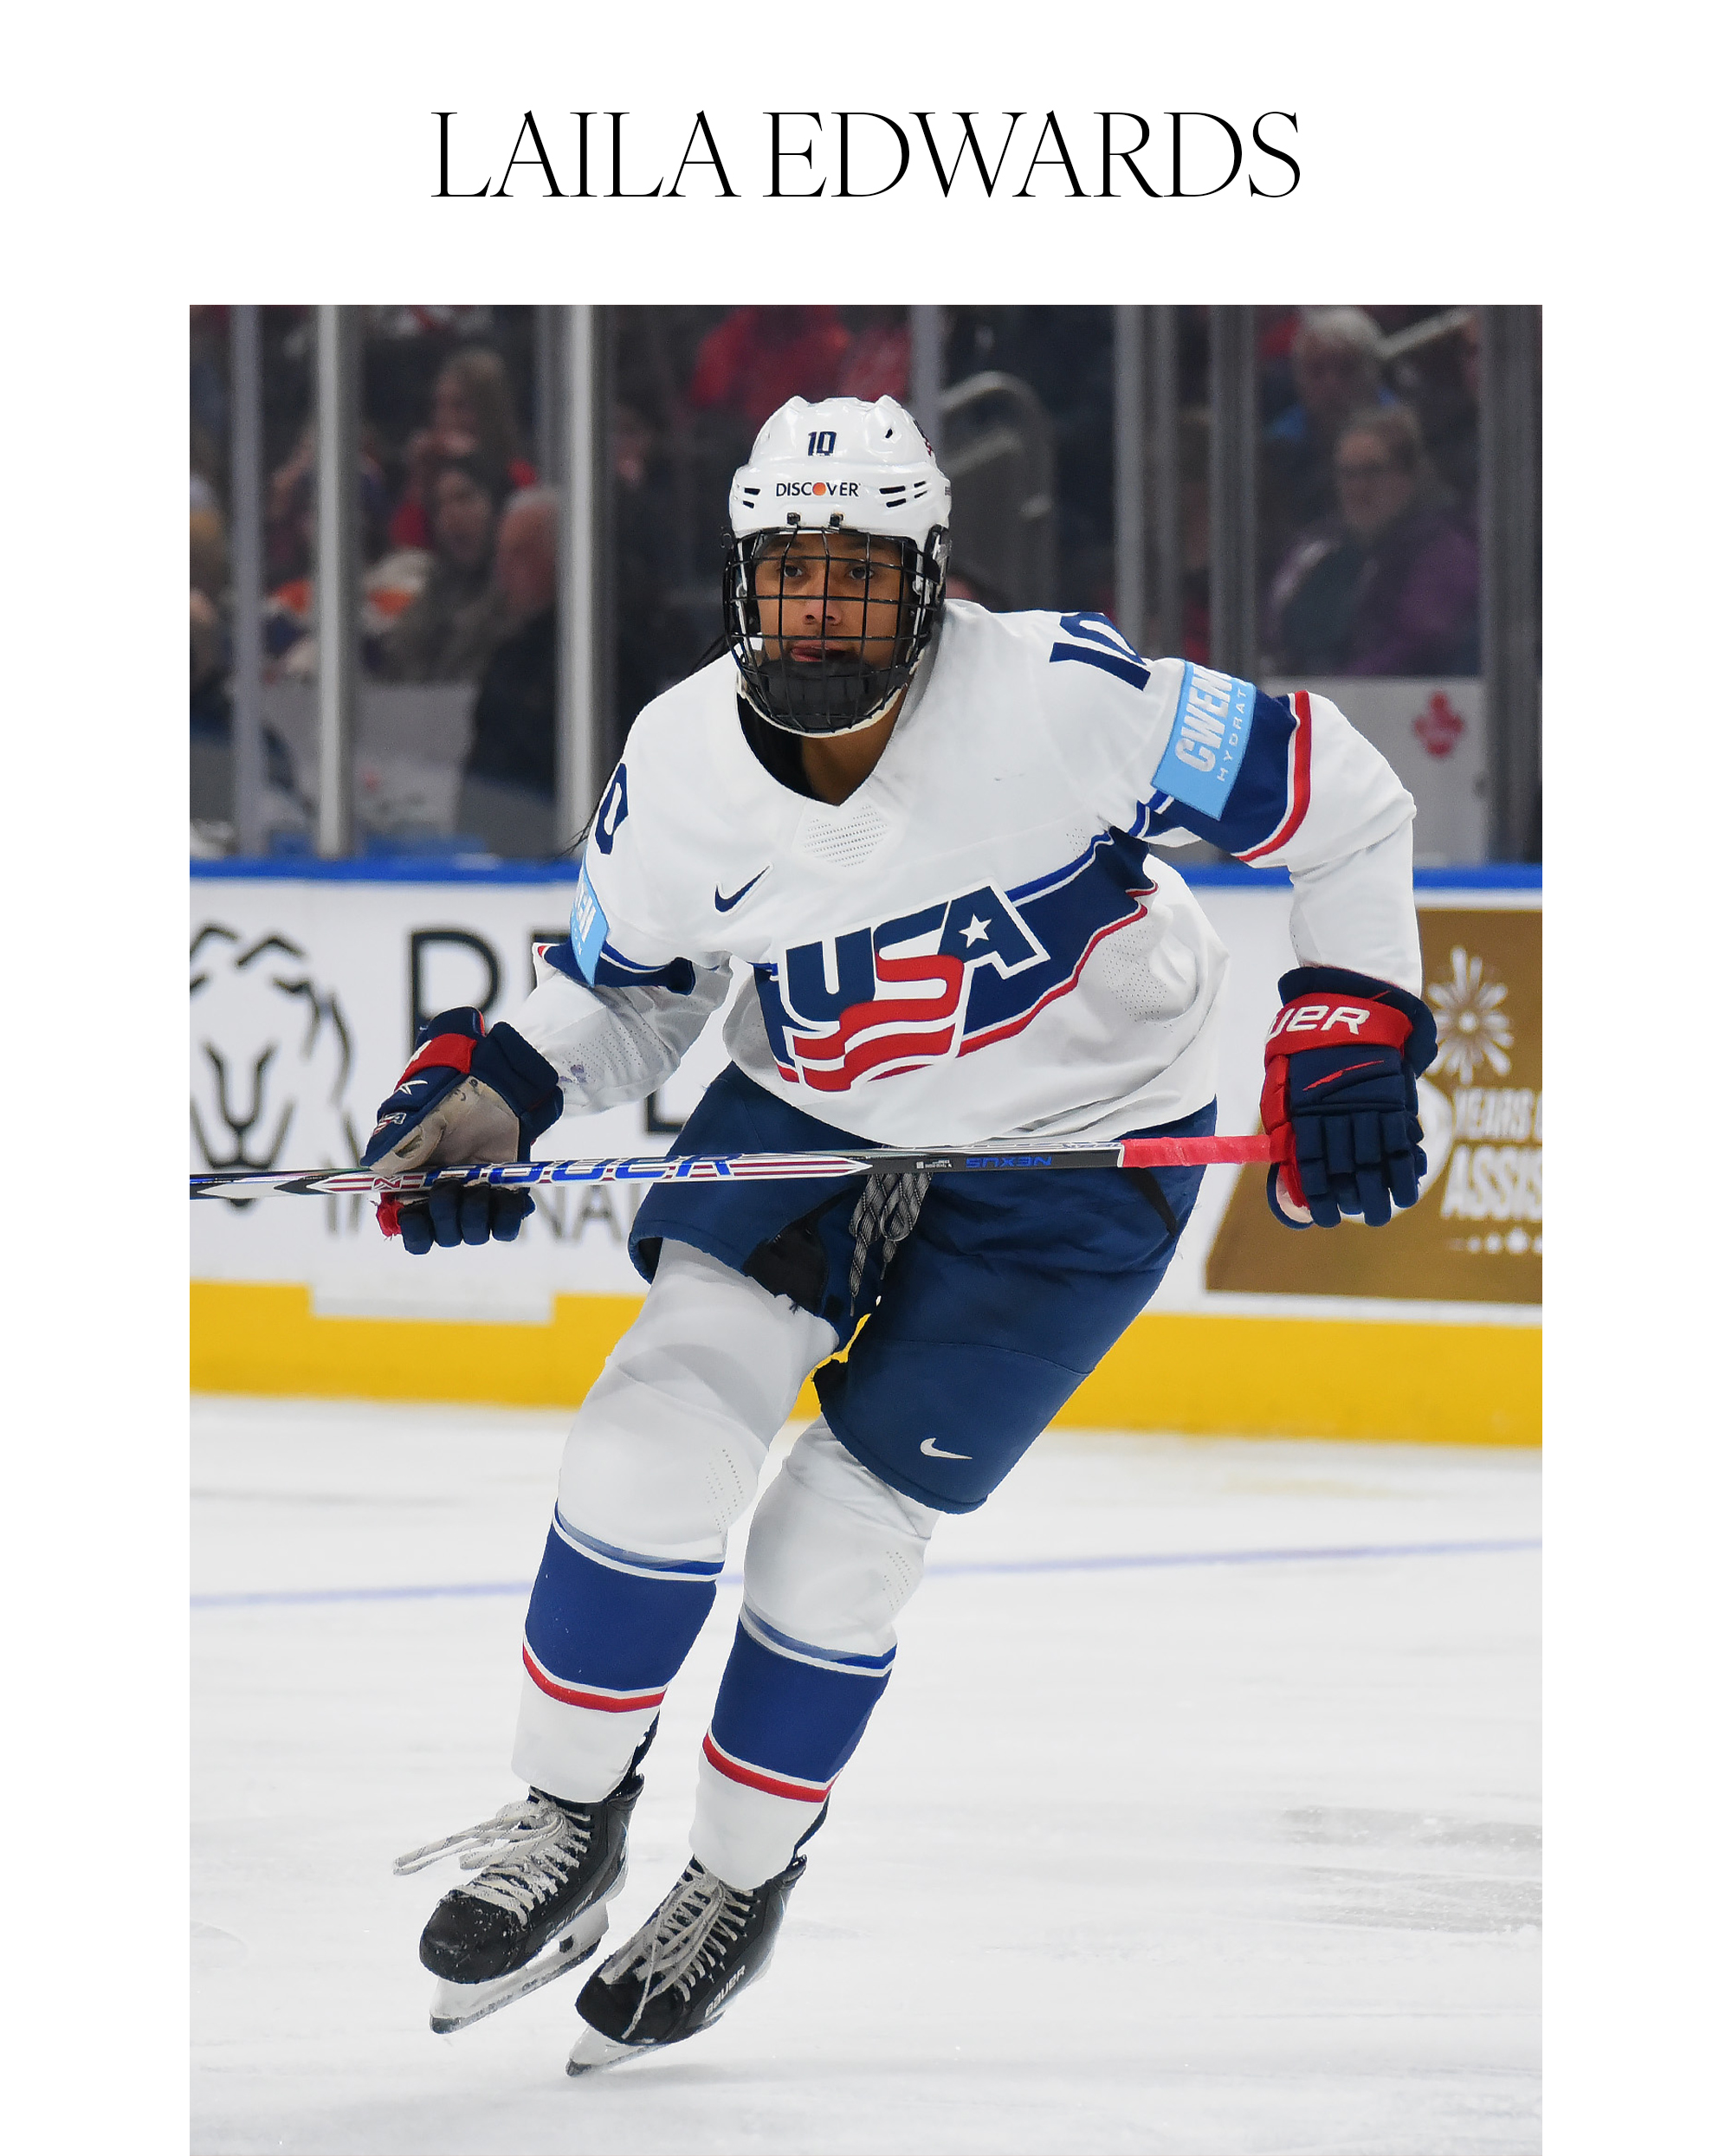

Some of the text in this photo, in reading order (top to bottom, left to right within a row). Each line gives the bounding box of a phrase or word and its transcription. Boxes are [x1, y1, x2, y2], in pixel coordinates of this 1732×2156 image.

[807, 430, 837, 456] 10
[776, 481, 861, 498] DISCOVER
[1049, 611, 1152, 692] 10
[1174, 664, 1232, 772] CWEN
[784, 879, 1050, 1093] USA
[966, 1156, 1052, 1168] NEXUS
